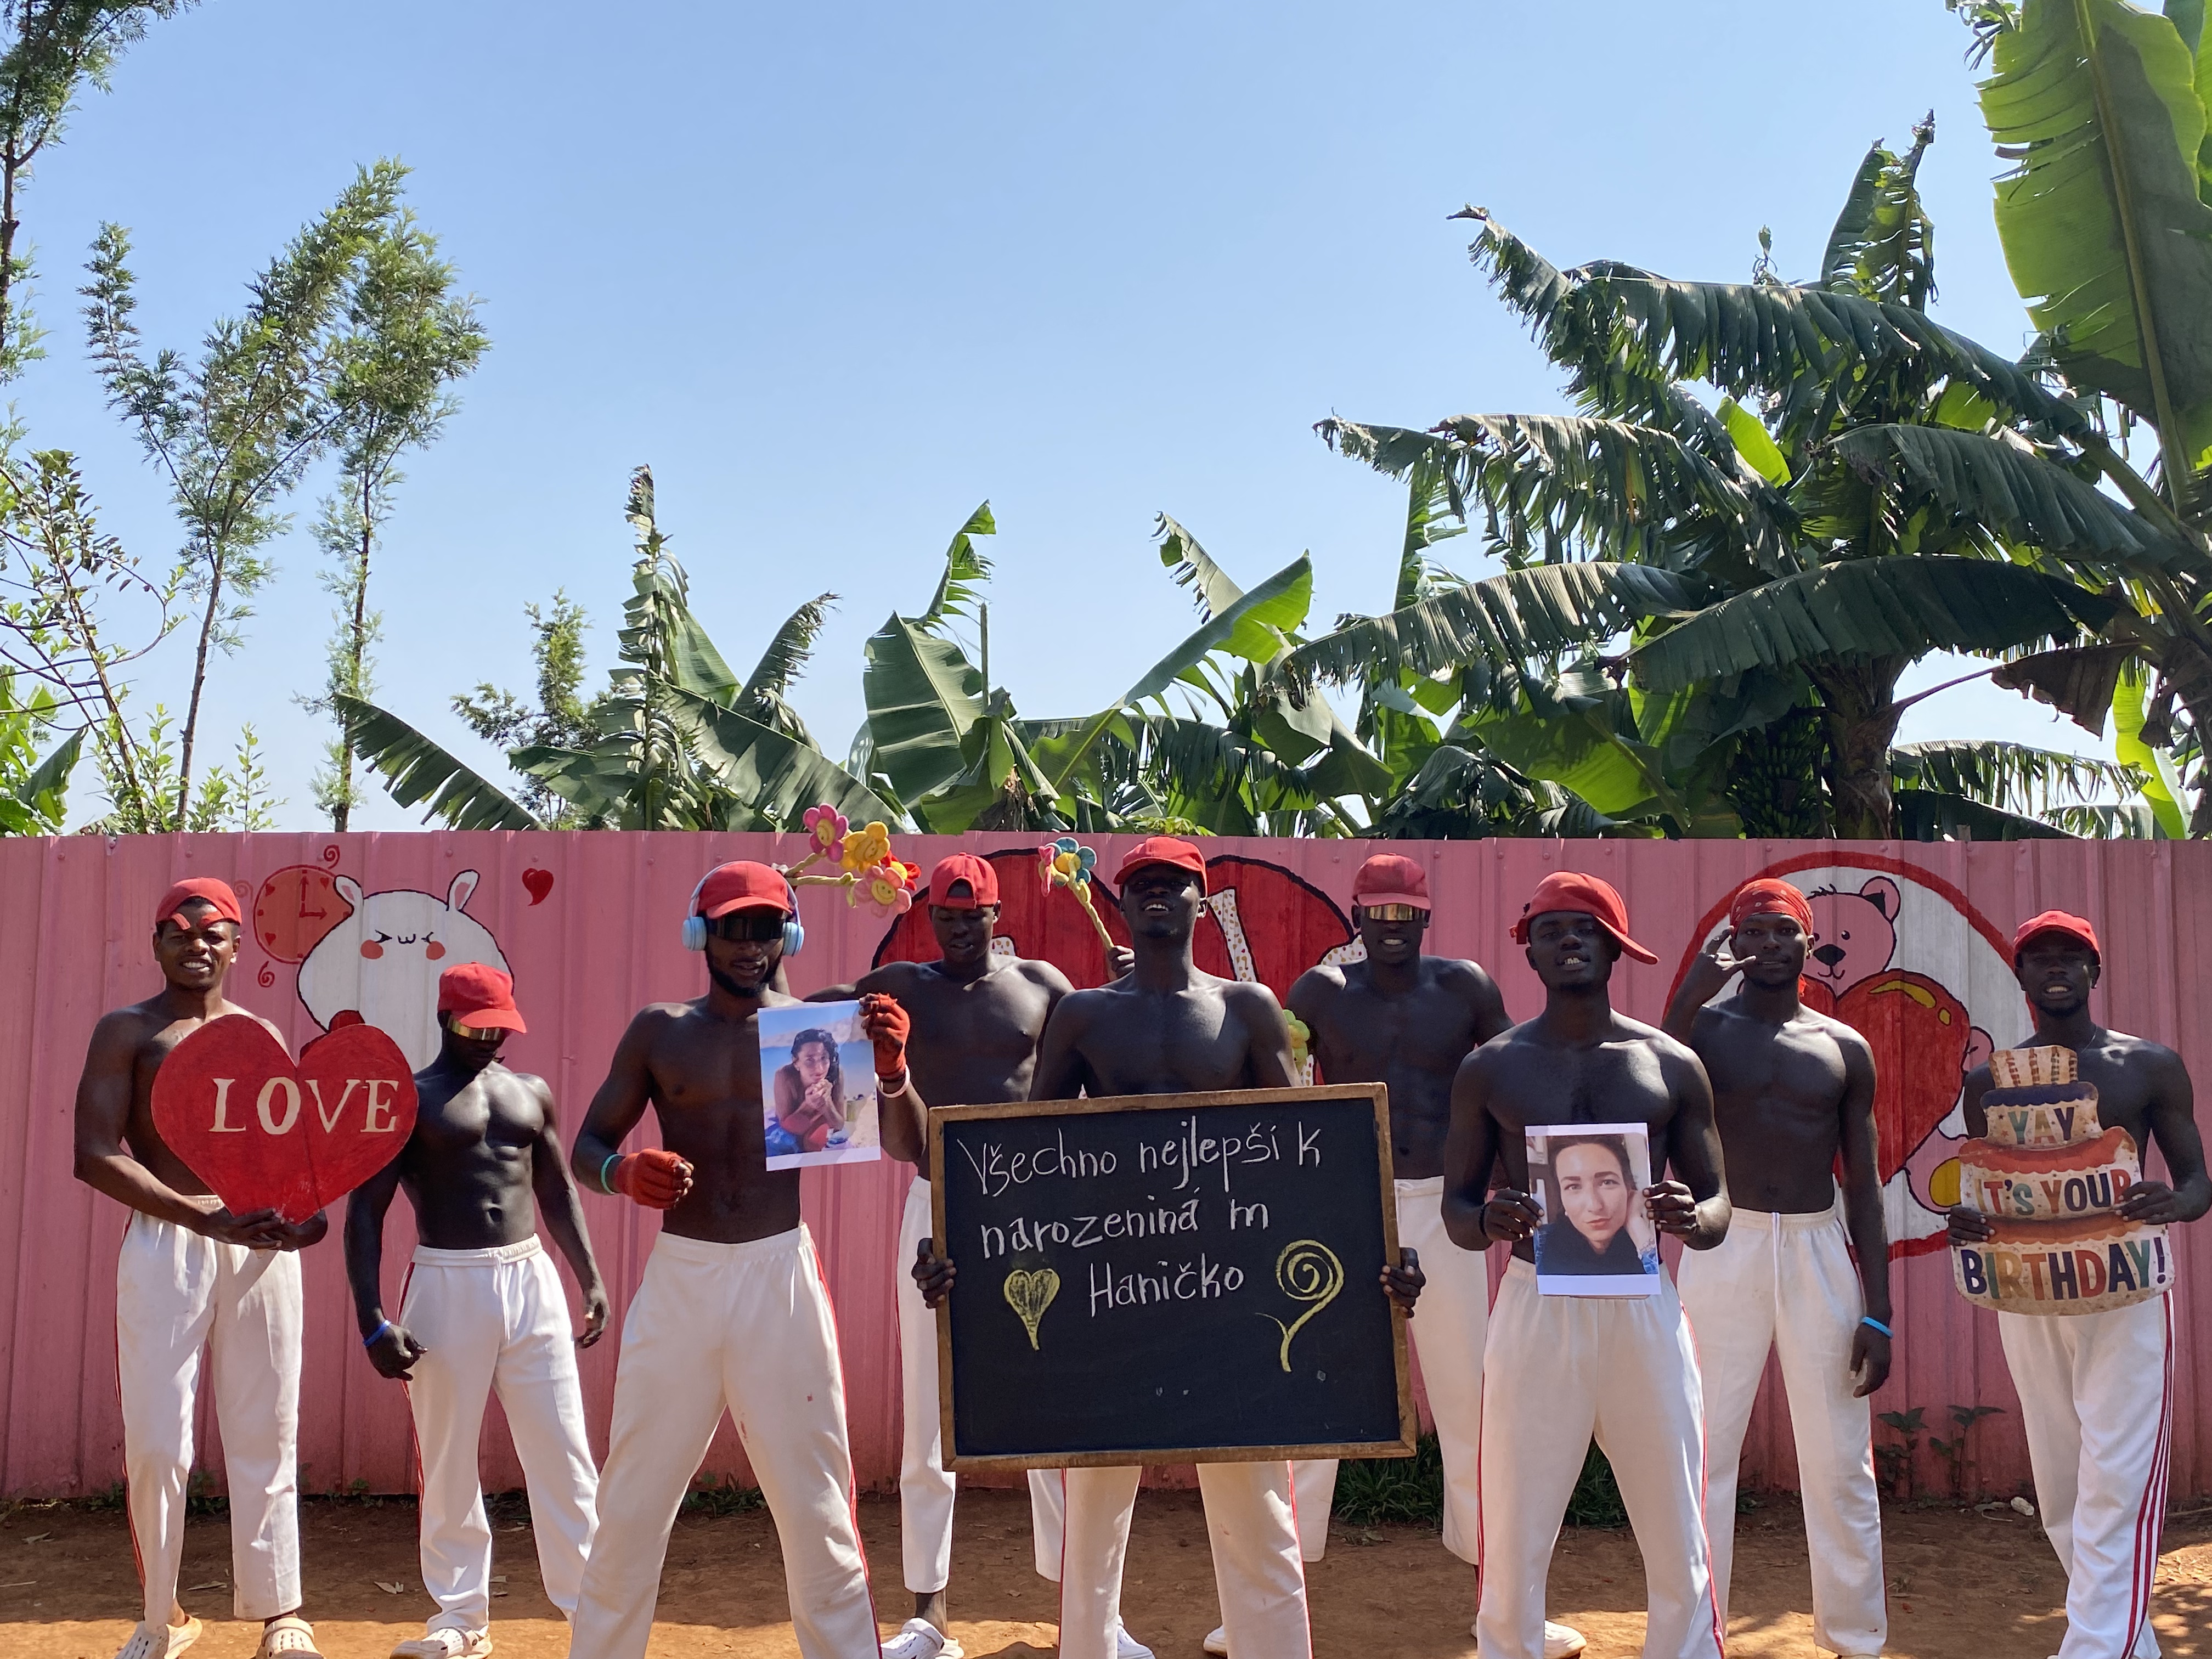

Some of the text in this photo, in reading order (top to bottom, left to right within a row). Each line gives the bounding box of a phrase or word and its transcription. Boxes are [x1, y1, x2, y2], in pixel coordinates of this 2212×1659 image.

[208, 1076, 399, 1135] LOVE
[2008, 1107, 2074, 1144] YAY
[957, 1128, 1116, 1197] Všechno
[1140, 1115, 1280, 1193] nejlepší
[1229, 1199, 1269, 1231] m
[1974, 1179, 2035, 1215] IT'S
[1090, 1252, 1244, 1317] Haničko
[1960, 1237, 2166, 1301] BIRTHDAY!
